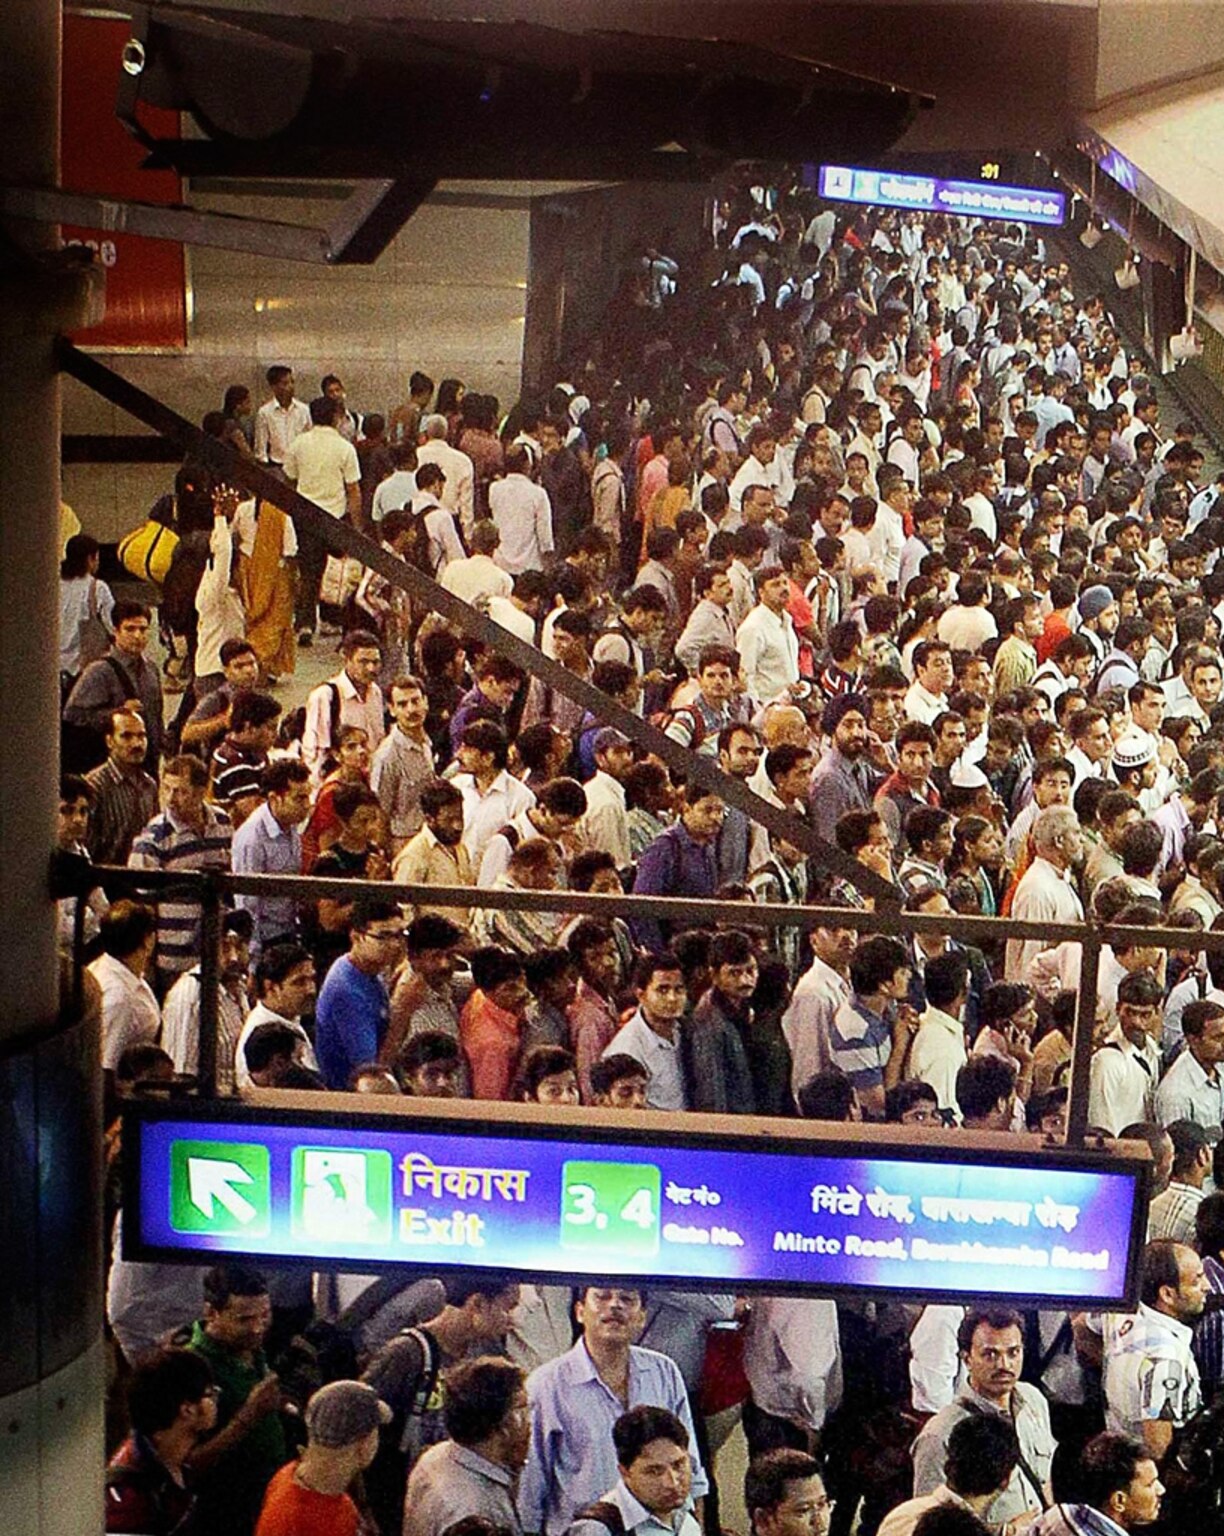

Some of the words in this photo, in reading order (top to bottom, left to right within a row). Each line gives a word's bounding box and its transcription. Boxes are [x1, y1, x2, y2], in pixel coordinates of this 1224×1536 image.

[398, 1151, 530, 1202] निकास
[399, 1208, 485, 1247] Exit
[620, 1188, 656, 1230] 4
[772, 1231, 842, 1256] Minto
